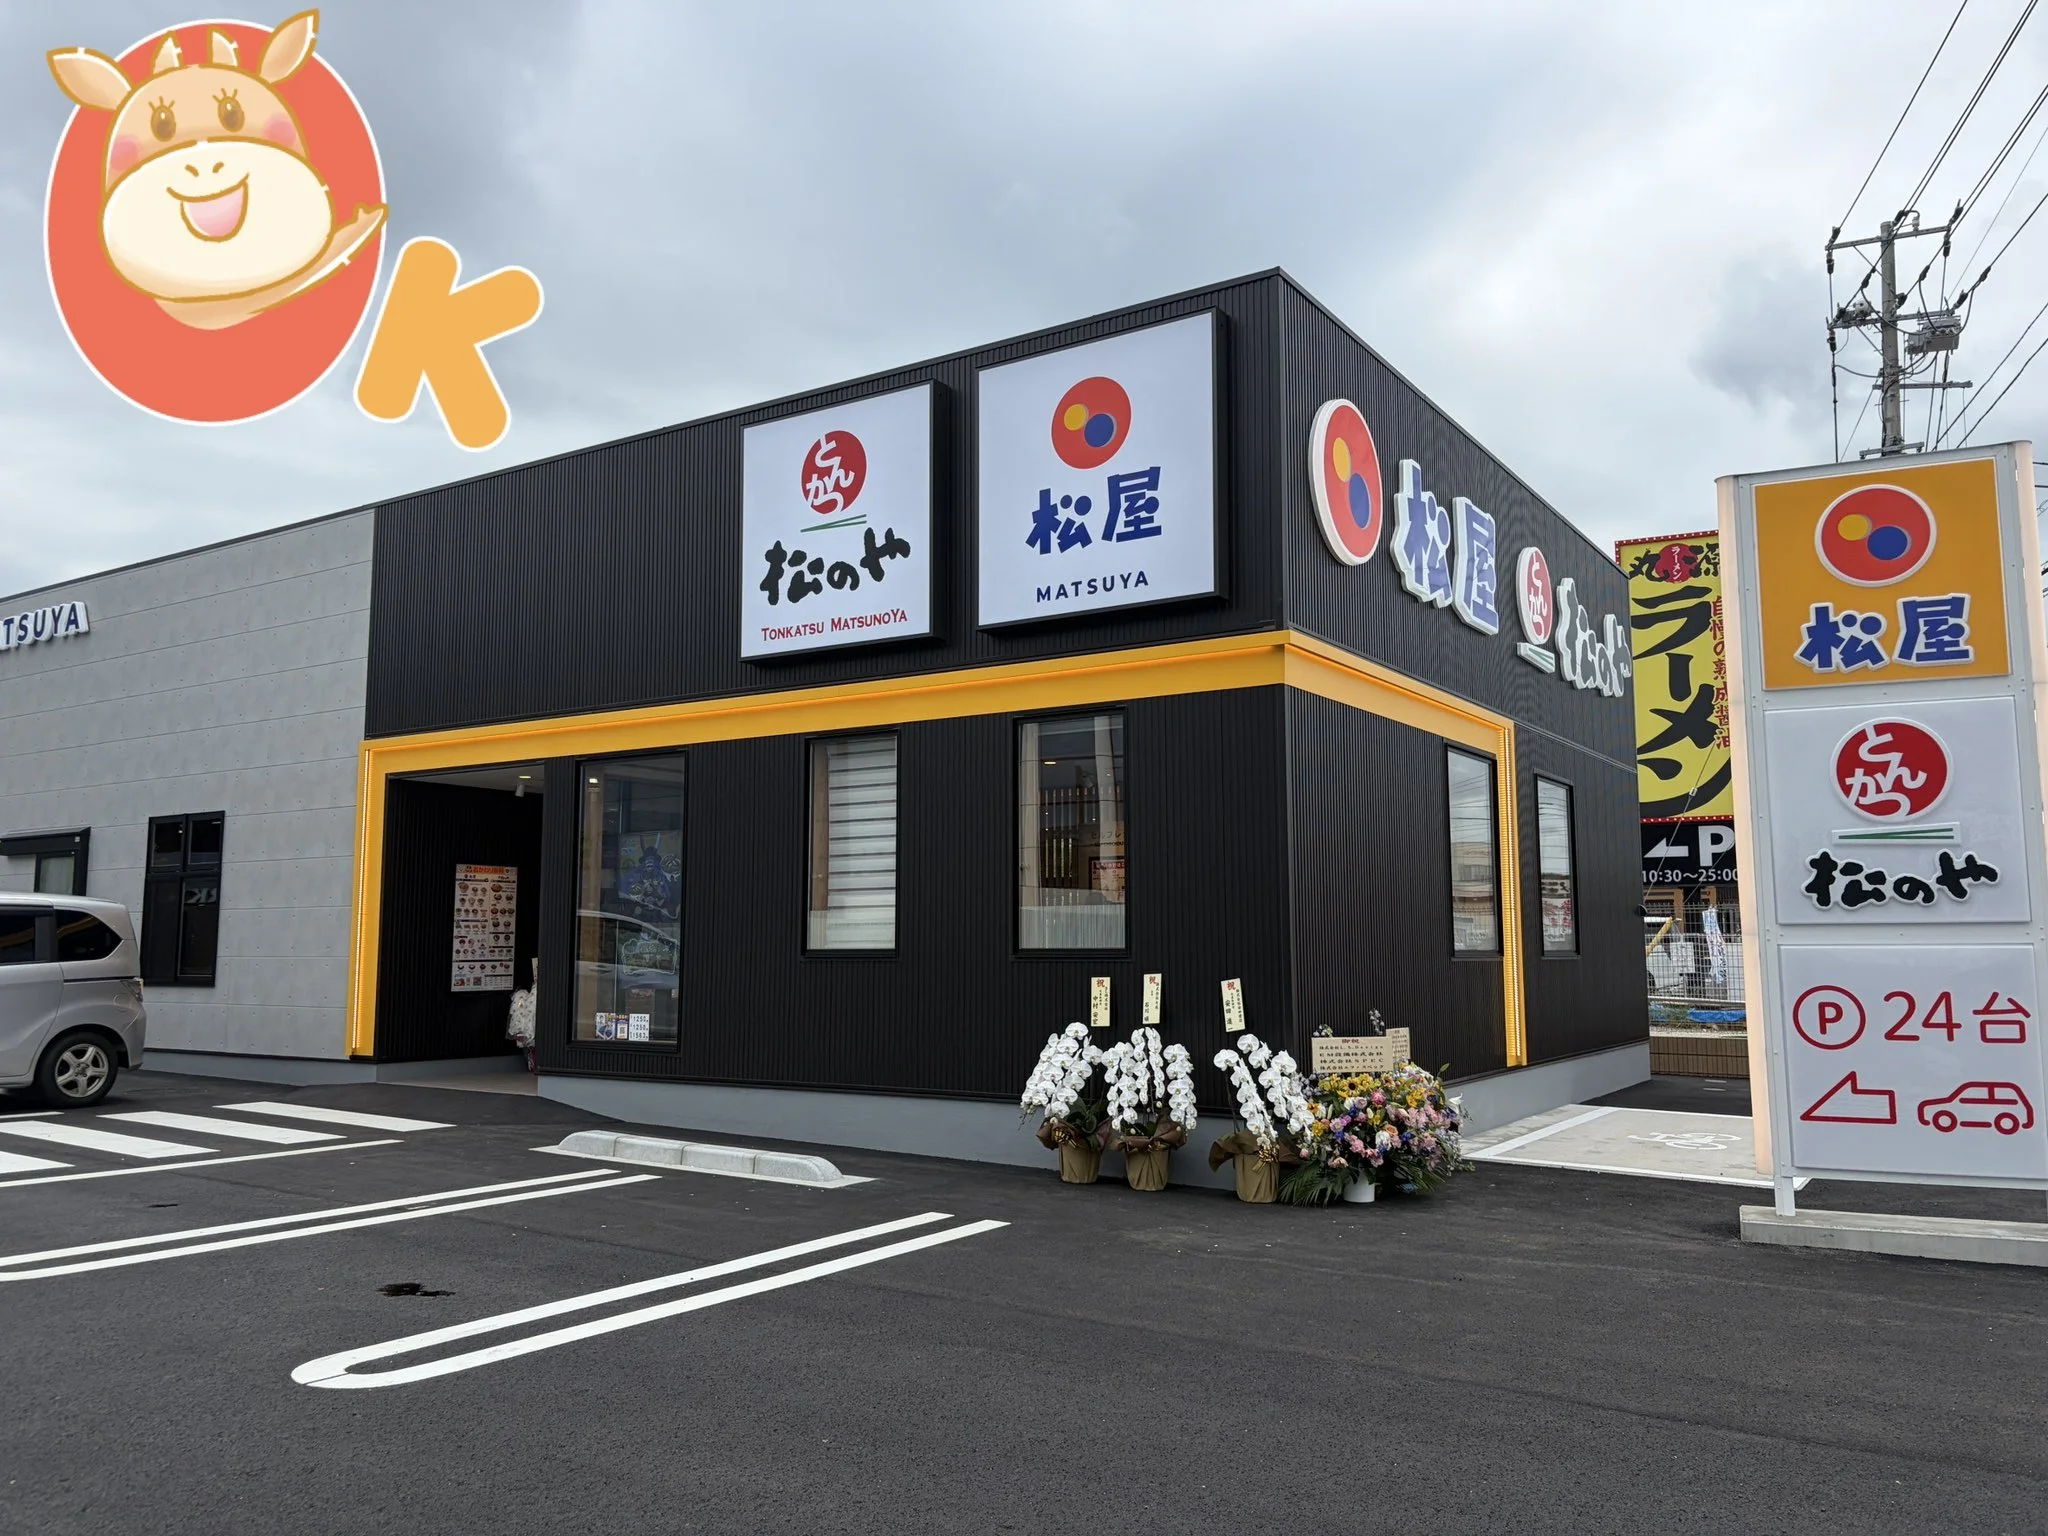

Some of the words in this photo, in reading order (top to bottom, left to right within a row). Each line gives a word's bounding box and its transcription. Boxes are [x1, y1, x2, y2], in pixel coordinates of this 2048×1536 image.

[806, 434, 855, 512] とんかつ
[1025, 466, 1162, 555] 松屋
[759, 527, 911, 605] 松のや
[1399, 464, 1497, 630] 松屋
[1036, 570, 1149, 603] MATSUYA
[761, 621, 825, 642] TONKATSU
[1797, 595, 1972, 670] 松屋
[1631, 585, 1733, 819] ラーメン
[1845, 726, 1928, 816] とんかつ
[1698, 825, 1735, 867] P
[1804, 850, 2000, 908] 松のや
